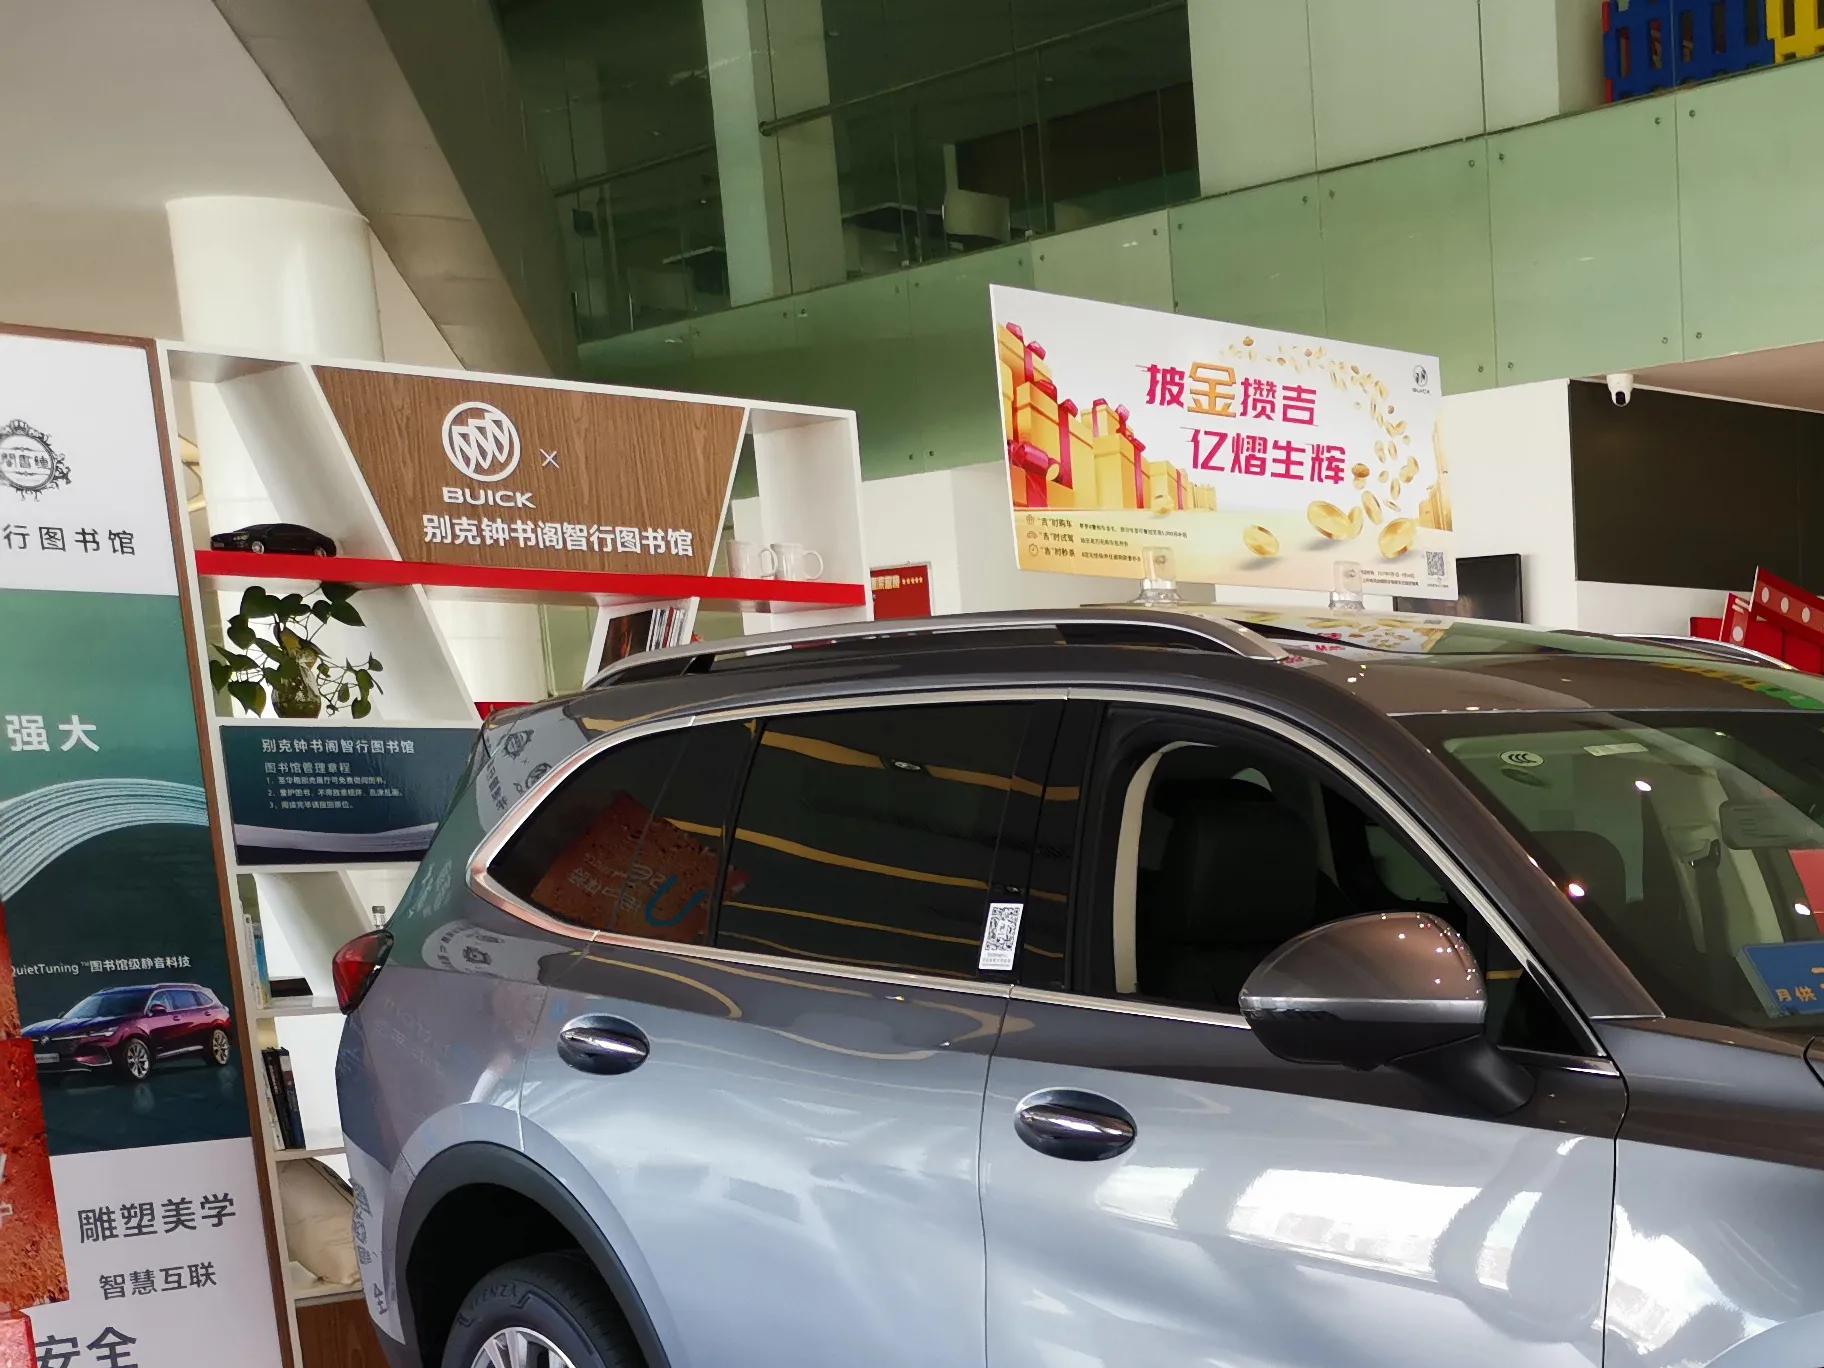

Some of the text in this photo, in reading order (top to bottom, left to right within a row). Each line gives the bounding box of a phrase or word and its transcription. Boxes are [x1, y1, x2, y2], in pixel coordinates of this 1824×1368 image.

[1138, 361, 1318, 427] 披金攒吉
[1184, 426, 1346, 486] 亿熠生辉
[442, 487, 537, 509] BUICK
[3, 523, 136, 556] 行图书馆
[422, 514, 693, 557] 别克钟书阁智行图书馆
[5, 714, 101, 753] 强大
[262, 738, 415, 754] 别克钟书阁智行图书馆
[77, 1191, 237, 1245] 雕塑美学
[99, 1260, 218, 1303] 智慧互联
